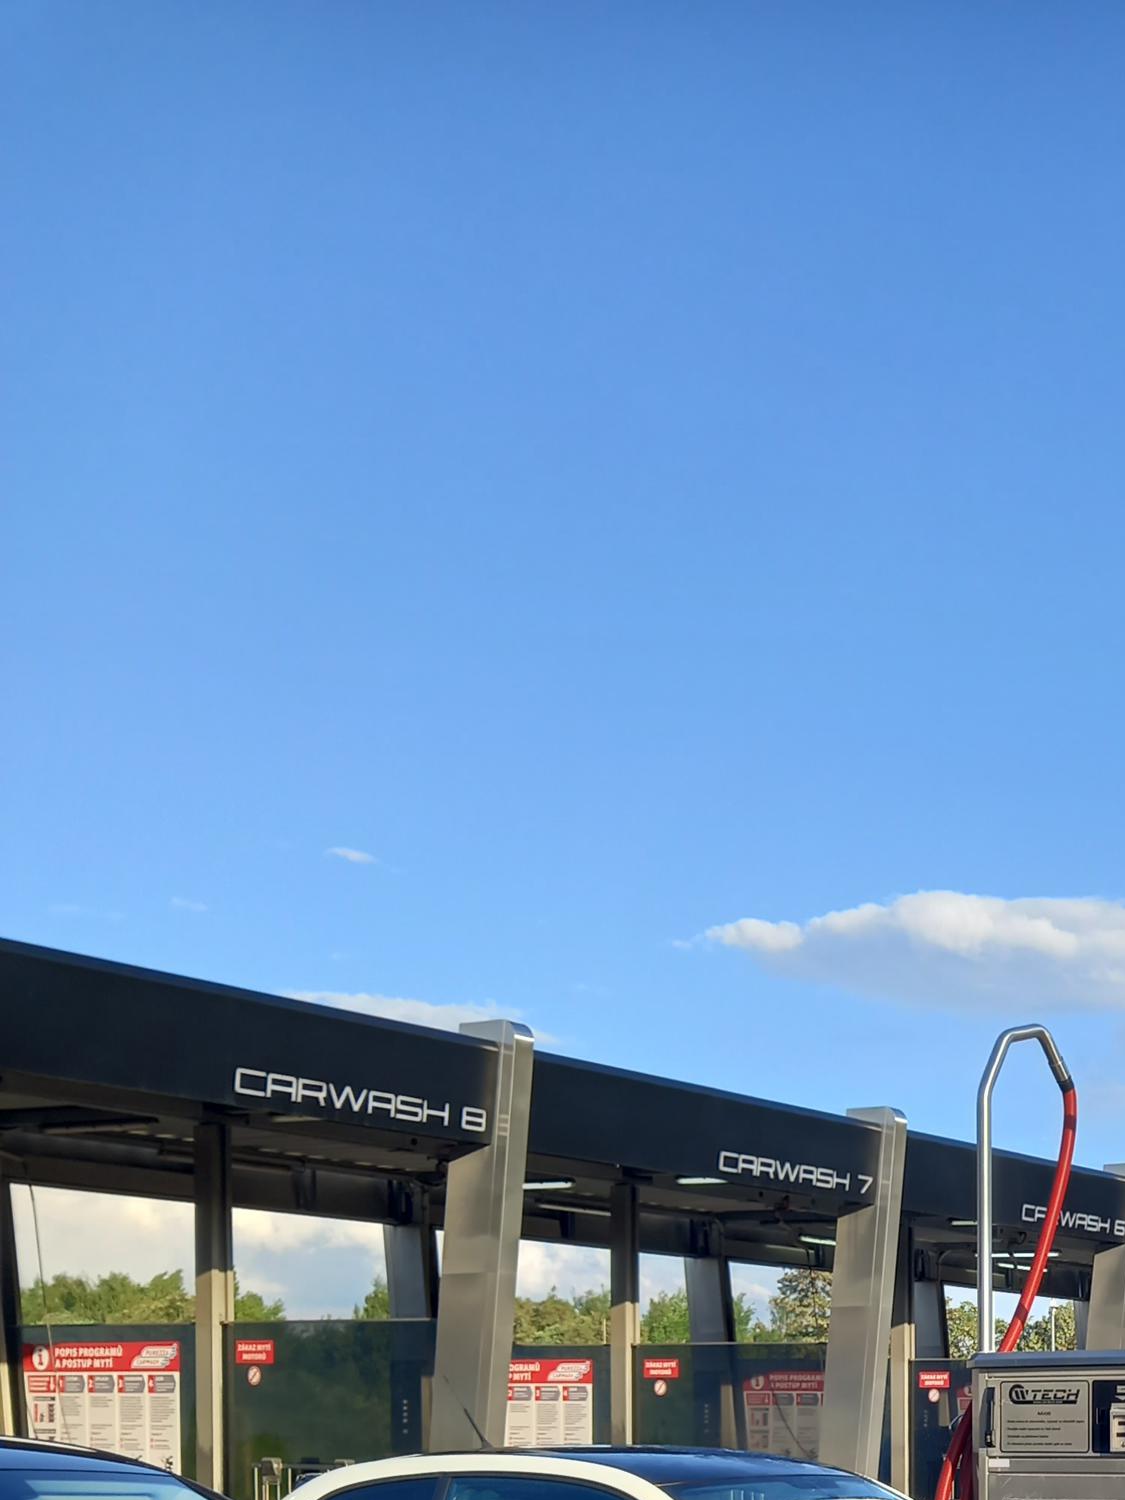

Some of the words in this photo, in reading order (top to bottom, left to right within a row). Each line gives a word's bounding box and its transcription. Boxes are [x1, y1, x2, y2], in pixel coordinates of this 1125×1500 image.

[234, 1067, 450, 1126] CARWASH
[461, 1106, 487, 1132] 8
[718, 1151, 850, 1191] CARWASH
[857, 1174, 873, 1194] 7
[1022, 1204, 1110, 1234] CAWASH
[1113, 1219, 1125, 1236] 6
[54, 1347, 77, 1357] POPIS
[62, 1358, 92, 1368] POSTUP
[509, 1361, 541, 1372] OGRAMŮ
